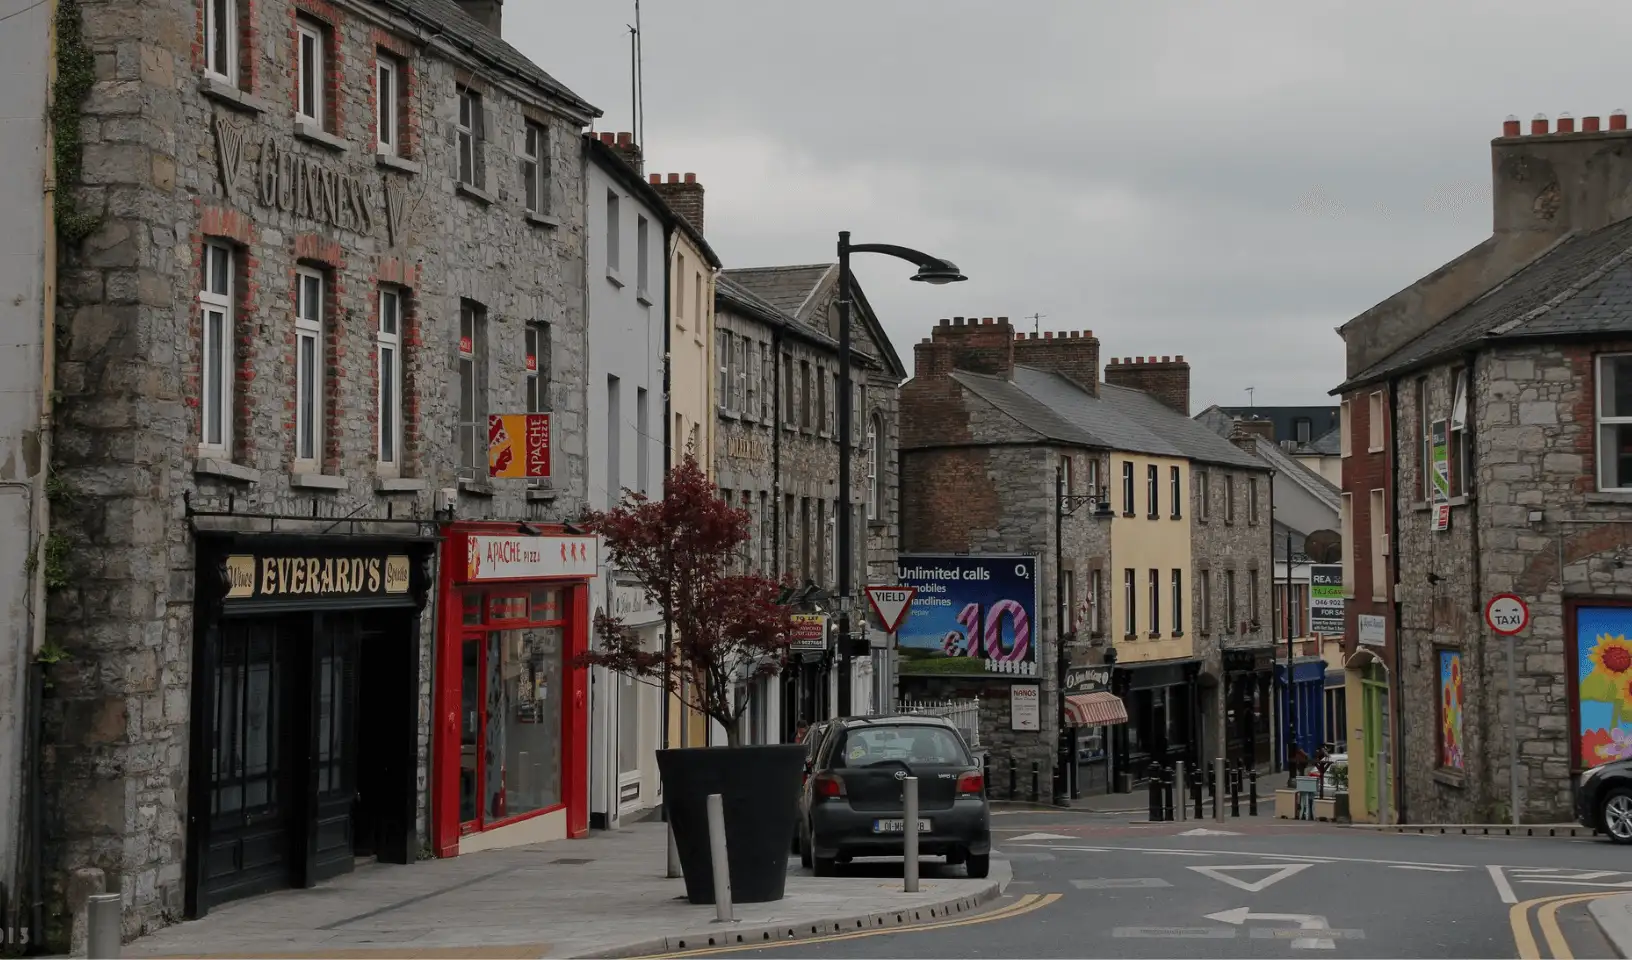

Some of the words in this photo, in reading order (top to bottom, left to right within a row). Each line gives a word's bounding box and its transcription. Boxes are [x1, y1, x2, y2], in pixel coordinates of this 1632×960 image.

[261, 136, 373, 237] GUINNESS
[531, 418, 545, 475] APACHE
[487, 540, 521, 572] APACHE
[523, 551, 541, 563] PIZZA
[229, 565, 253, 588] Wines
[260, 556, 381, 595] EVERARD'S
[897, 566, 960, 580] Unlimited
[962, 566, 990, 581] calls
[1313, 576, 1331, 584] REA
[875, 591, 906, 602] YIELD
[1494, 614, 1521, 625] TAXI
[1013, 689, 1037, 697] NANOS
